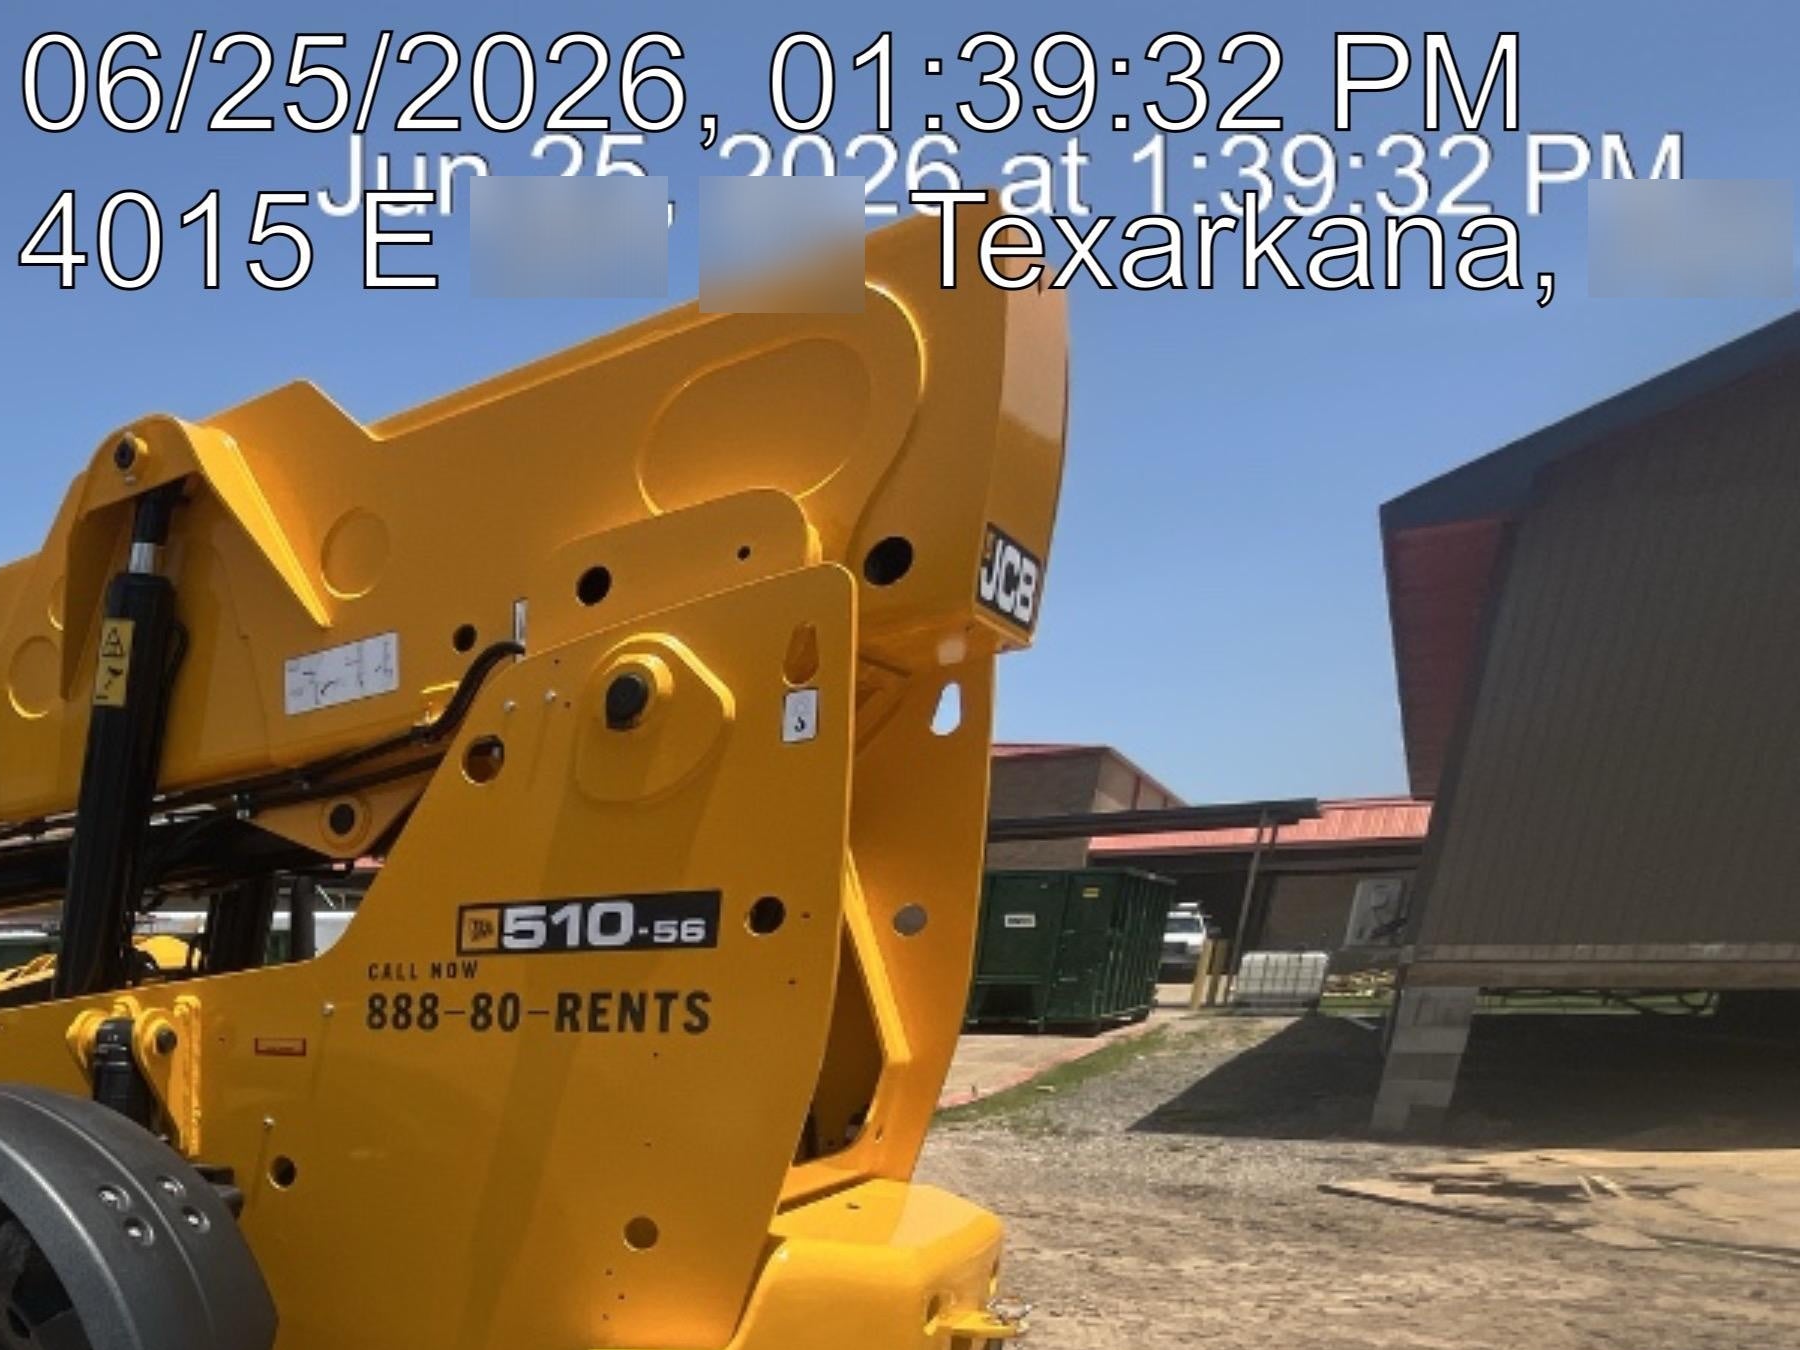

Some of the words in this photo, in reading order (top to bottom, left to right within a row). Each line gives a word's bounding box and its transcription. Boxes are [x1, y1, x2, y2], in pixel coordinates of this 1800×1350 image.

[981, 538, 1038, 623] JCB
[503, 901, 707, 949] 510-56
[368, 962, 418, 981] CALL
[431, 960, 478, 979] NOW
[367, 991, 712, 1034] 888-80-RENTS
